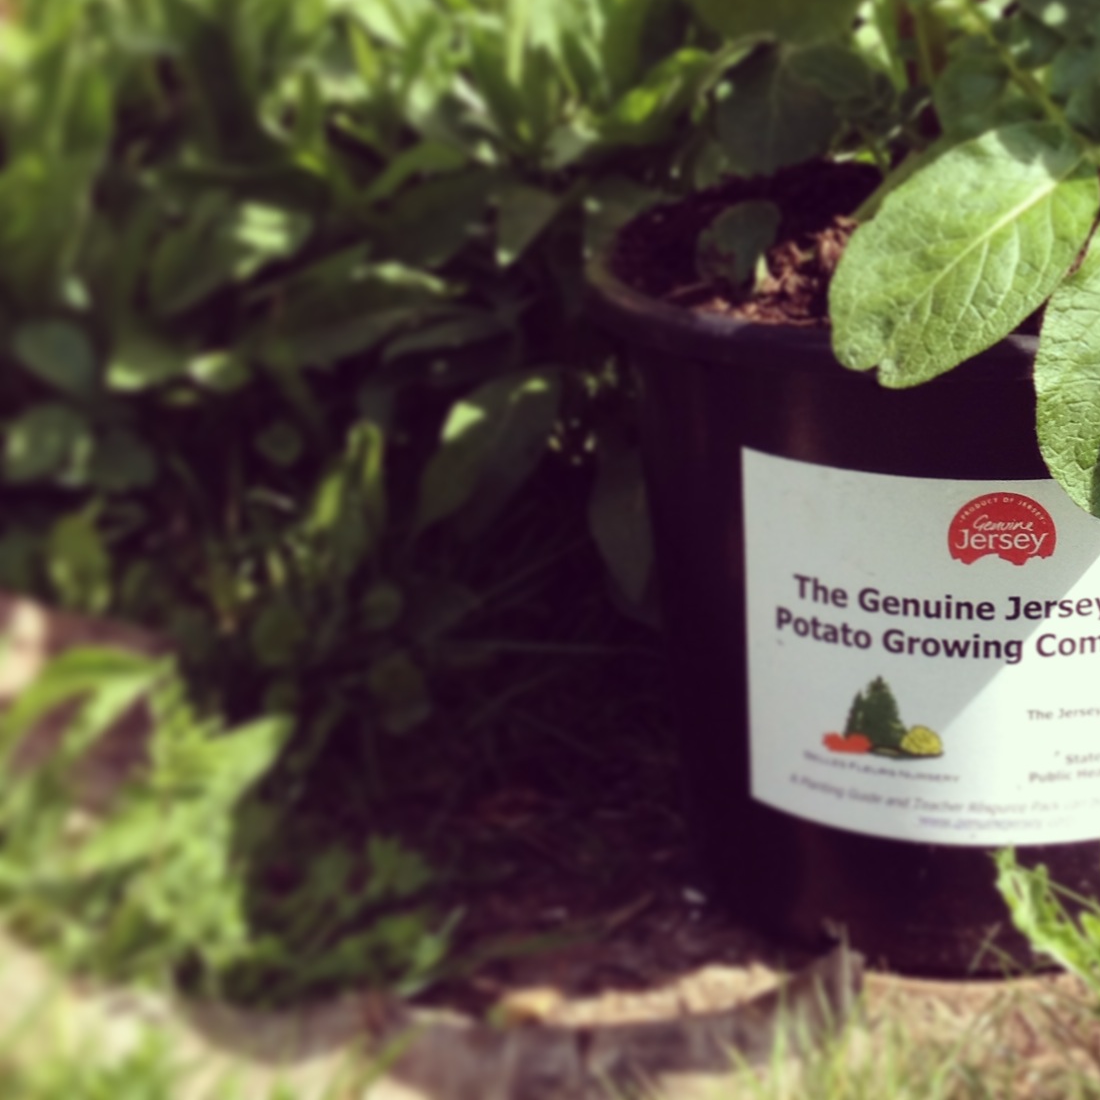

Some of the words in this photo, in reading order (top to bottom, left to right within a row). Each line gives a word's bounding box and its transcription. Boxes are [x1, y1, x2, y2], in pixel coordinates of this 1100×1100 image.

[961, 497, 998, 520] PRODUCT
[1018, 501, 1045, 521] JERSEY
[973, 514, 1034, 532] Genuine
[954, 529, 1049, 555] Jersey
[793, 573, 848, 609] The
[858, 587, 996, 622] Genuine
[776, 605, 872, 650] Potato
[882, 628, 1024, 665] Growing
[1026, 709, 1054, 721] The
[1028, 770, 1072, 783] Public
[886, 796, 910, 808] and
